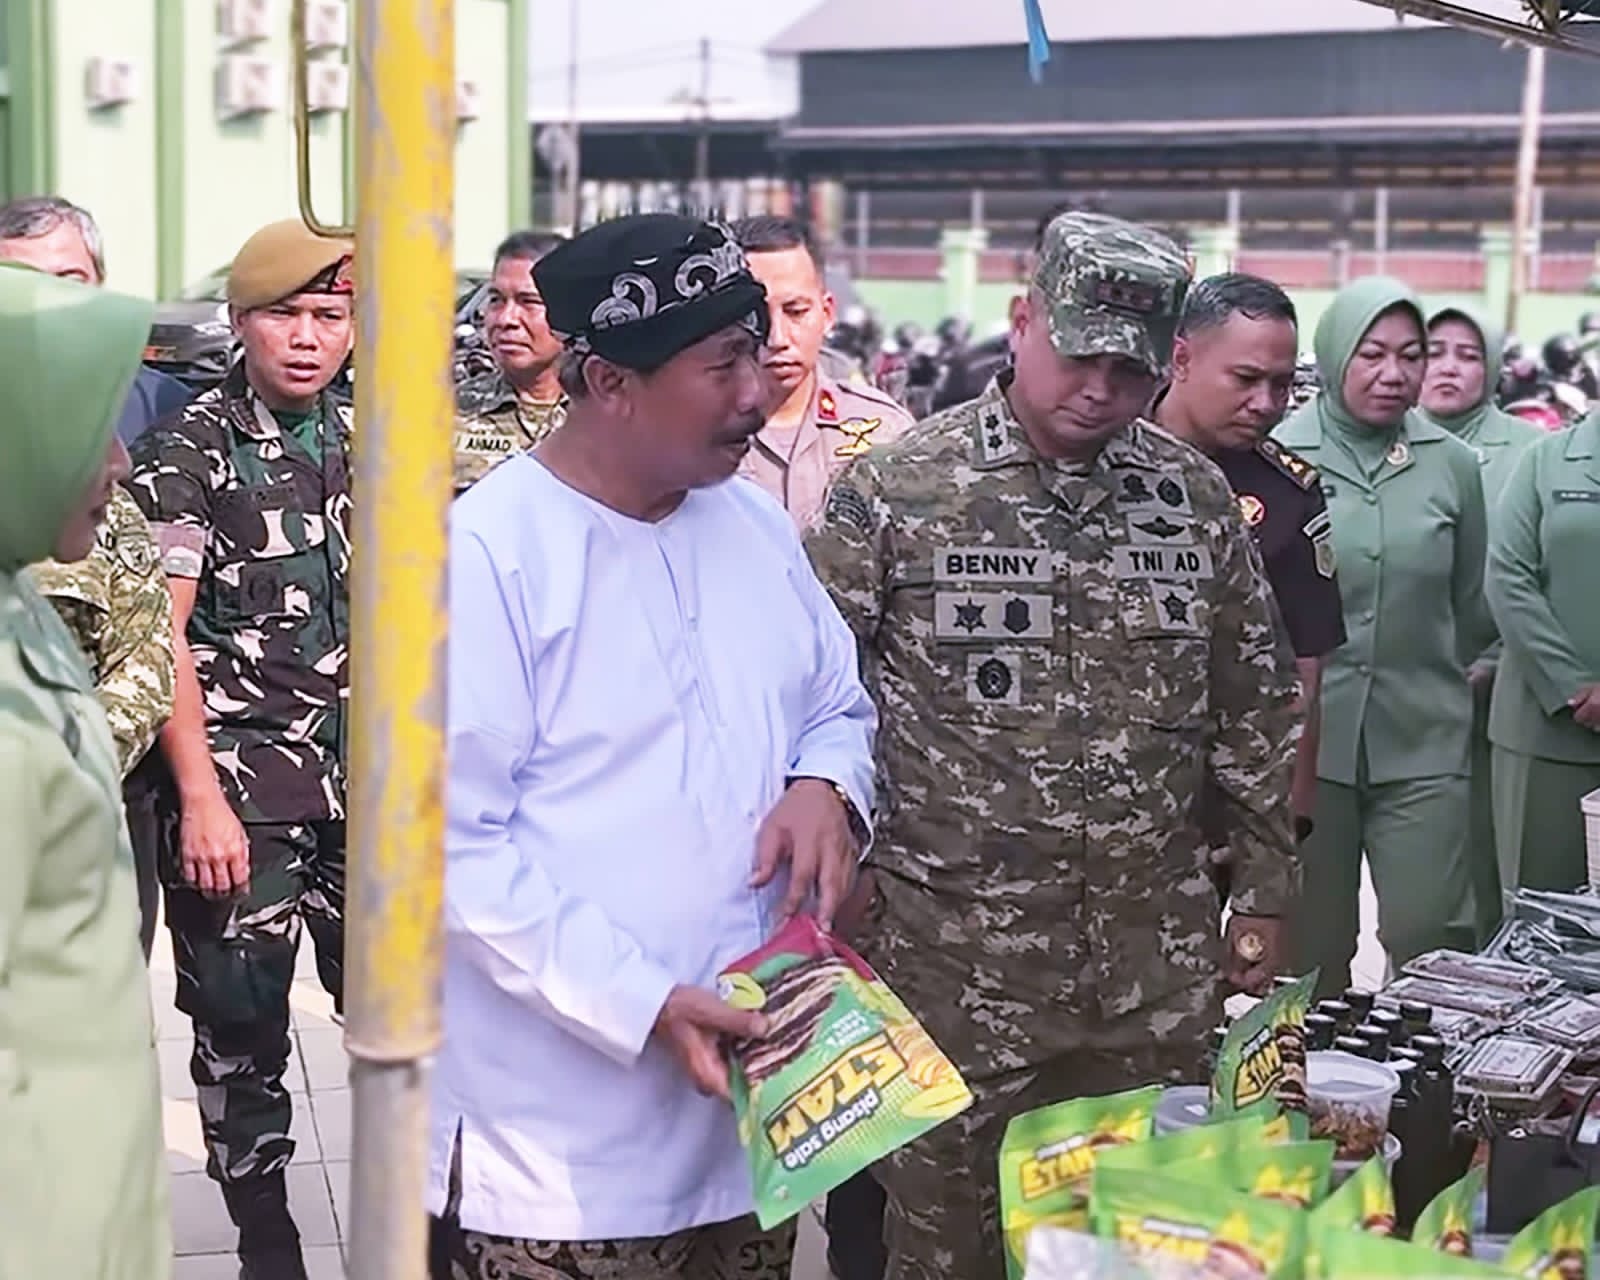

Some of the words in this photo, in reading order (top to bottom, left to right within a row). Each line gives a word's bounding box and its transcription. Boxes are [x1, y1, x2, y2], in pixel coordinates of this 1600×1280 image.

[946, 554, 1039, 576] BENNY
[1128, 551, 1164, 572] TNI
[1174, 551, 1200, 572] AD
[767, 1047, 906, 1156] ETAM
[820, 1087, 879, 1142] pisang
[783, 1133, 823, 1169] sale
